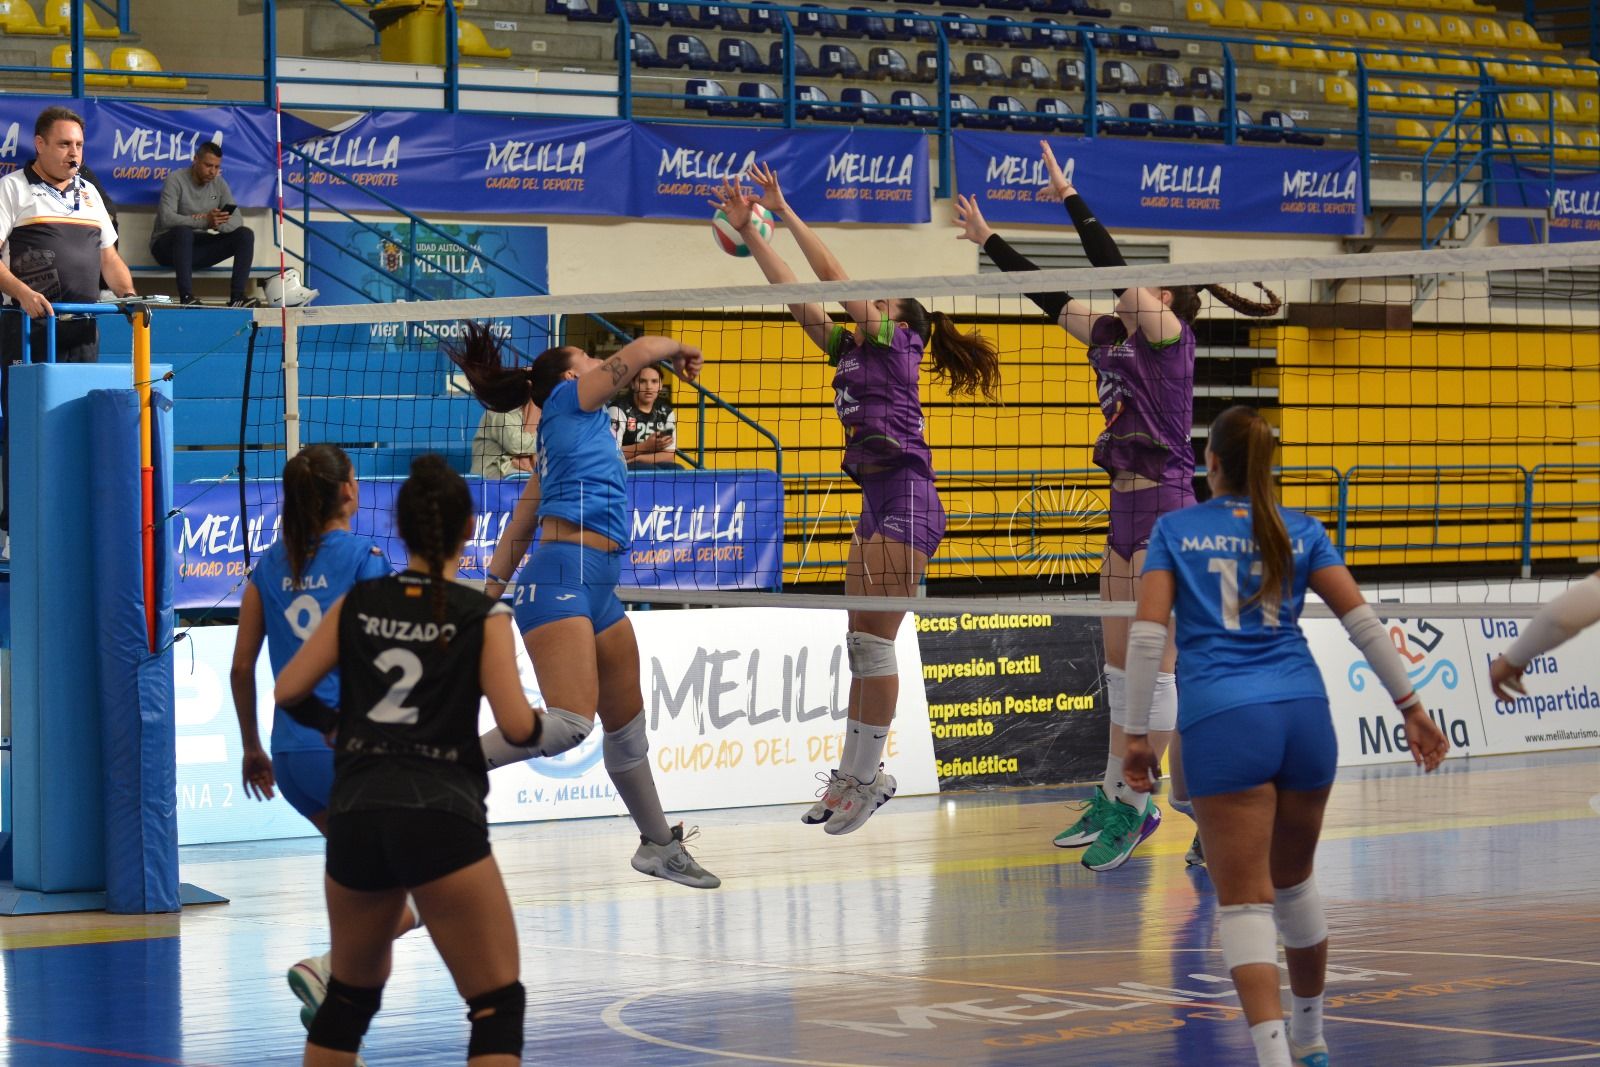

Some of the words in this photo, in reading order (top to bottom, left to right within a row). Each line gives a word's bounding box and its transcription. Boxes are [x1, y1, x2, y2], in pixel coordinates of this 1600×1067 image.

[485, 140, 586, 174] MELILLA
[658, 147, 756, 181] MELILLA
[826, 152, 913, 185] MELILLA
[986, 155, 1075, 186] MELILA
[153, 167, 171, 180] DE
[352, 173, 399, 187] DEPORTE
[486, 177, 520, 190] CIUDAD
[522, 178, 540, 190] DEL
[543, 178, 585, 192] DEPORTE
[1141, 163, 1221, 195] MELILLA
[1283, 170, 1357, 199] MELILLA
[657, 183, 693, 196] CIUDAD
[875, 189, 913, 202] DEPORTE
[178, 513, 283, 557] MELILL
[630, 501, 745, 544] MELILLA
[630, 548, 672, 565] CIUDAD
[674, 546, 694, 563] DEL
[697, 545, 745, 562] DEPORTE
[179, 561, 224, 578] CIUDAD
[282, 573, 329, 592] PULA
[514, 583, 537, 606] 21
[1481, 617, 1519, 639] Una
[923, 658, 996, 683] mpresión
[998, 655, 1042, 676] Textil
[366, 647, 424, 725] 2
[650, 644, 851, 735] MELILL
[929, 697, 1001, 722] mpresión
[1004, 695, 1054, 715] Poster
[1056, 693, 1094, 711] Gran
[1494, 685, 1600, 720] compartida
[930, 720, 995, 739] Formato
[658, 740, 744, 773] CIUDAD
[754, 737, 797, 766] DEL
[935, 755, 1018, 777] Señalética
[517, 788, 549, 804] C.V.
